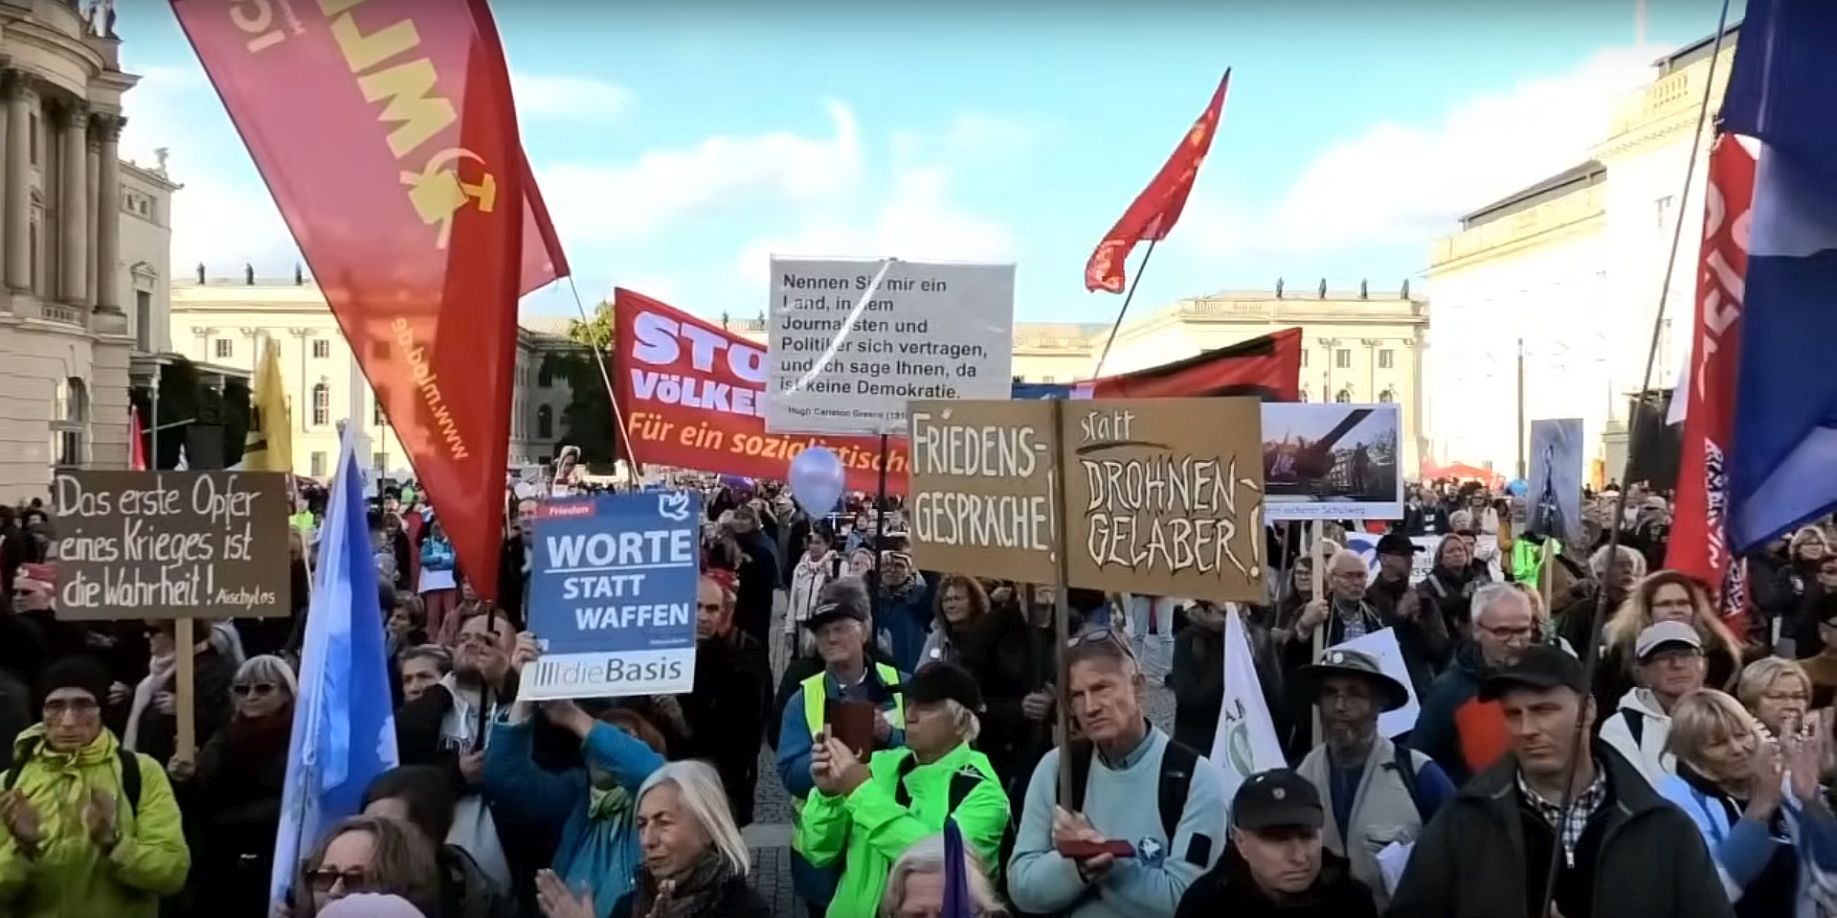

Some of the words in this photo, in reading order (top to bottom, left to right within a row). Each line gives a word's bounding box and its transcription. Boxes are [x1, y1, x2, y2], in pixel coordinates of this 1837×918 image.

[783, 274, 849, 290] Nennen
[887, 278, 916, 292] mir
[921, 279, 947, 292] ein
[836, 296, 851, 310] in
[857, 297, 894, 311] em
[782, 316, 889, 332] Journalsten
[895, 319, 928, 333] und
[857, 339, 893, 353] sich
[899, 343, 987, 359] vertragen,
[781, 358, 813, 372] und
[820, 359, 844, 373] ch
[850, 362, 891, 378] sage
[896, 360, 950, 378] Ihnen,
[956, 363, 977, 378] da
[806, 378, 851, 393] keine
[857, 380, 961, 399] Demokratie.
[628, 411, 674, 442] Für
[680, 421, 723, 450] ein
[1080, 409, 1135, 441] statt
[56, 475, 112, 517] Das
[119, 474, 182, 516] erste
[192, 473, 262, 527] Opfer
[60, 528, 119, 561] eines
[124, 517, 213, 569] Krieges
[222, 525, 253, 561] ist
[547, 529, 693, 569] WORTE
[63, 571, 101, 608] die
[563, 574, 645, 600] STATT
[575, 603, 689, 630] WAFFEN
